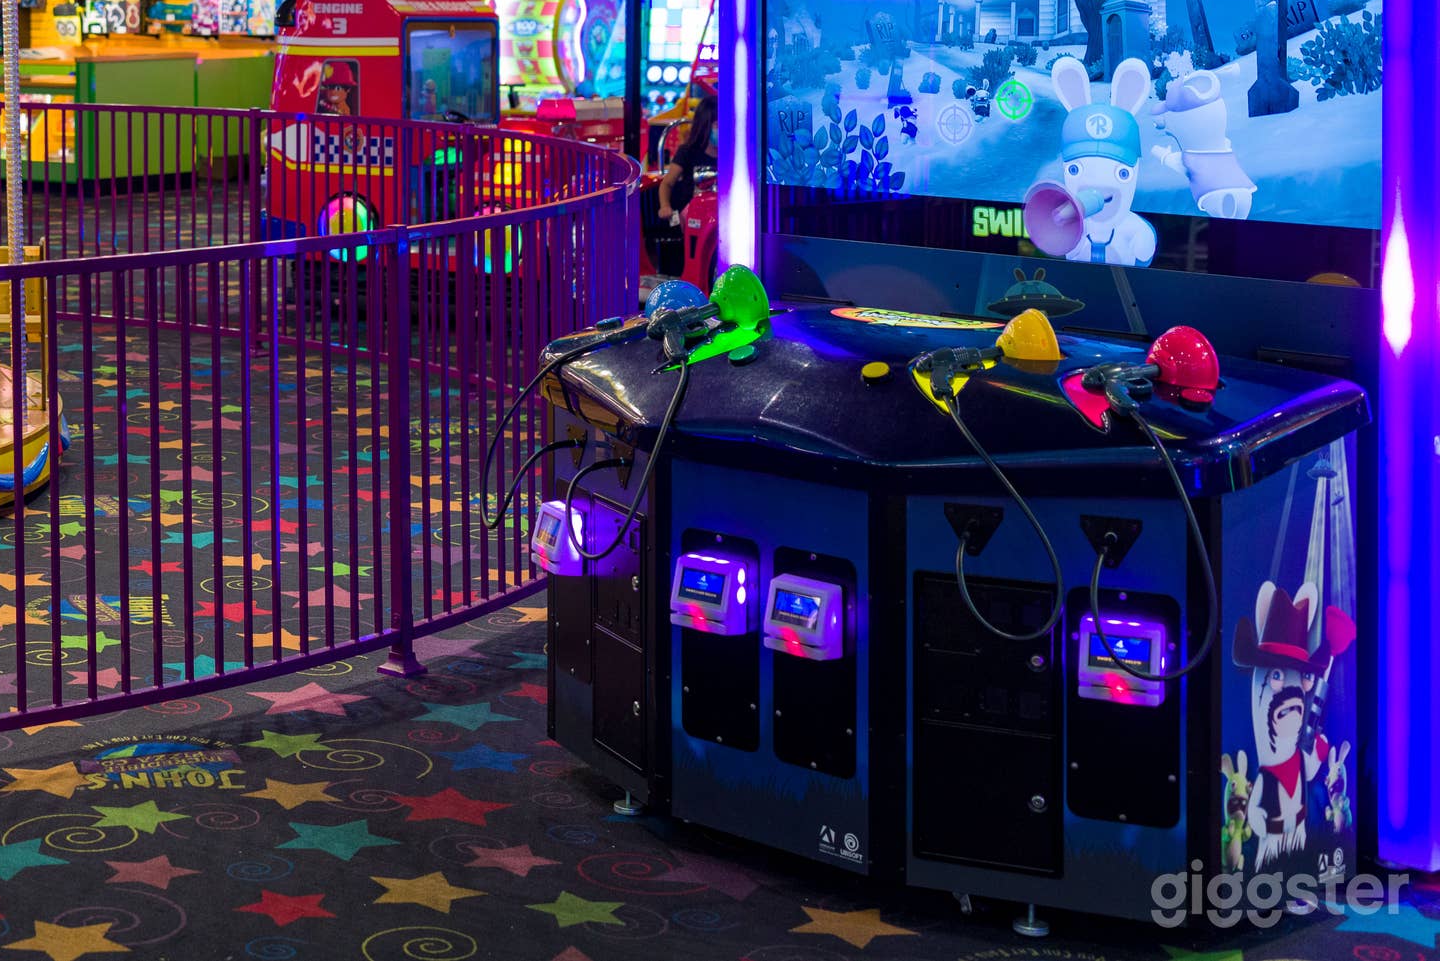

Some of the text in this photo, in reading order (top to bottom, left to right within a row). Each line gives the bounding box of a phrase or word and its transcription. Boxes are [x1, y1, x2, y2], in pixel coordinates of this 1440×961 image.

[313, 2, 363, 15] ENGINE
[1286, 0, 1307, 27] IP
[332, 17, 348, 35] 3
[875, 22, 895, 40] RIP
[777, 110, 806, 134] RIP
[972, 205, 1031, 239] SWI
[83, 769, 247, 790] JOHN'S
